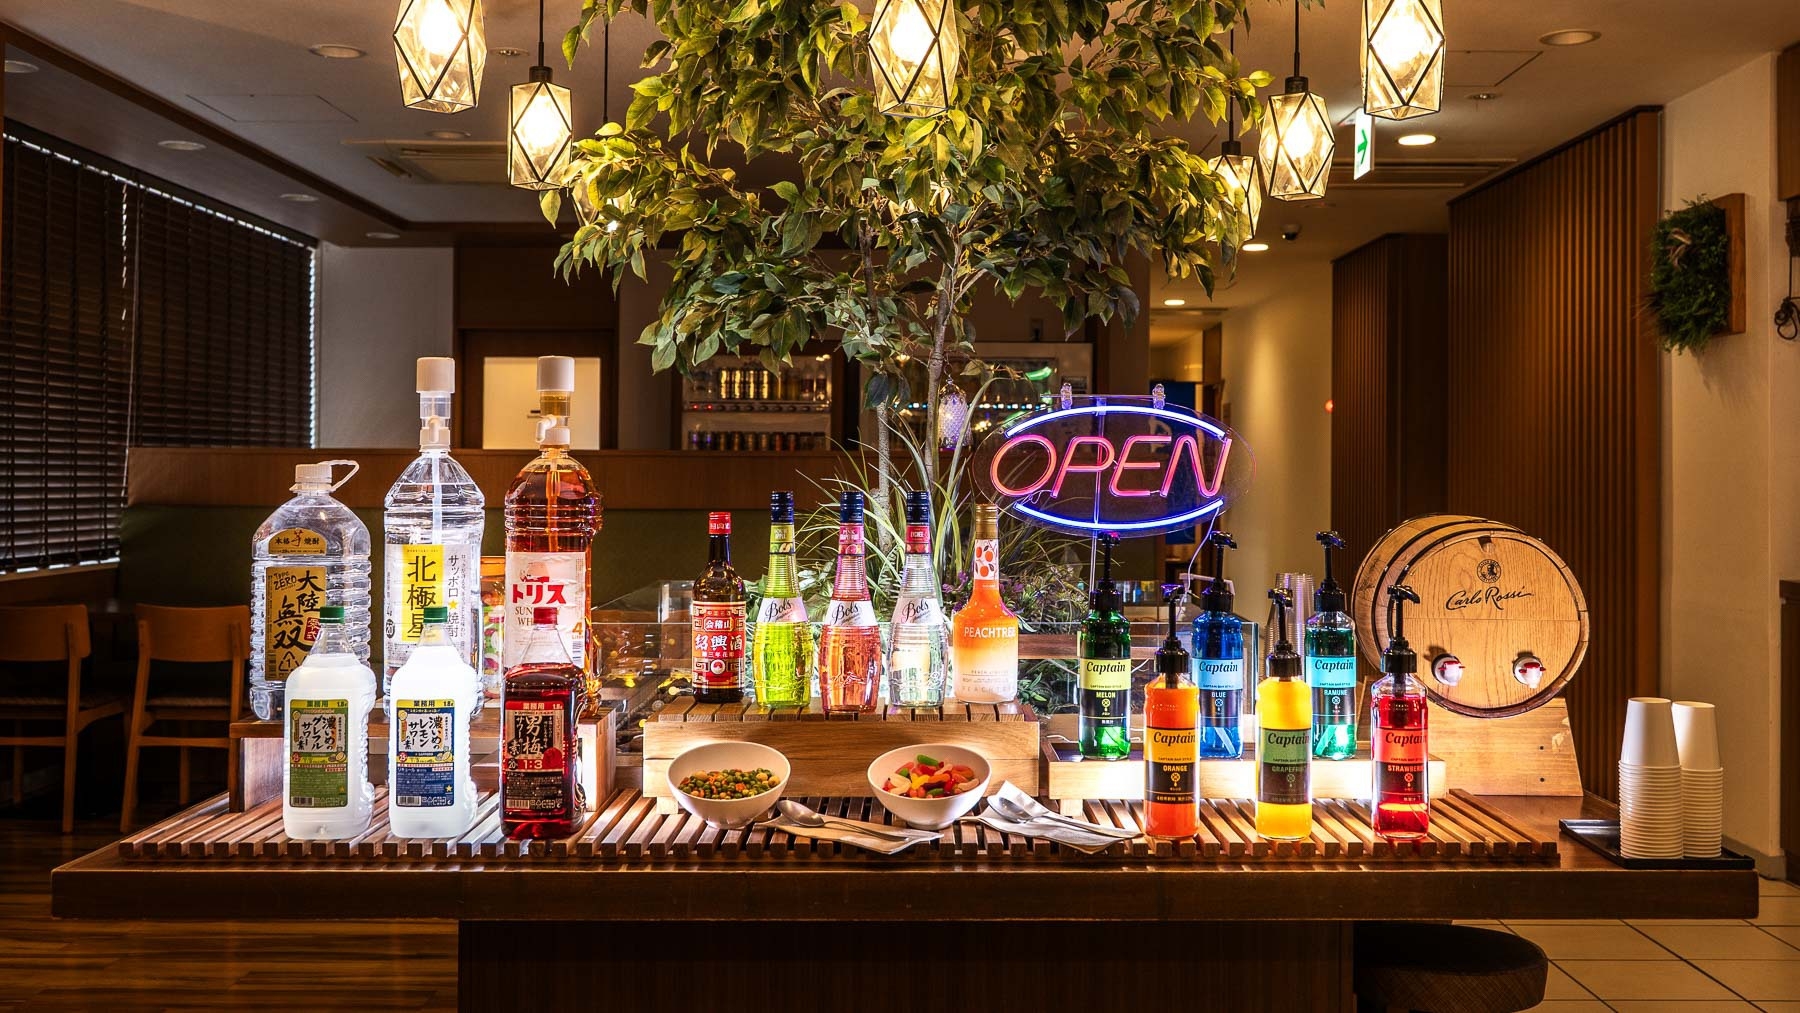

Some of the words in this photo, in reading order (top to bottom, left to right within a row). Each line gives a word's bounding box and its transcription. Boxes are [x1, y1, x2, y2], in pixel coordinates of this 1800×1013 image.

[990, 434, 1232, 498] OPEN
[273, 575, 297, 591] ZERO
[448, 554, 459, 598] サッポロ
[295, 570, 325, 613] 大陸
[407, 555, 437, 638] 北極星
[512, 584, 567, 605] トリス
[1446, 589, 1482, 611] Carlo
[1485, 586, 1534, 611] Rossi
[765, 600, 792, 621] Bols
[832, 600, 860, 623] Bols
[901, 601, 929, 622] Bols
[273, 594, 314, 652] 無双
[572, 621, 584, 636] 4
[964, 626, 1017, 639] PEACHTREE
[1086, 661, 1126, 675] Captain
[1199, 661, 1238, 675] Captain
[1314, 659, 1354, 673] Captain
[312, 715, 324, 751] グレフル
[322, 715, 337, 751] 濃いめの
[419, 718, 430, 748] レモン
[429, 715, 443, 750] 濃いめの
[522, 716, 544, 757] 男梅
[1153, 731, 1196, 747] Captain
[1268, 732, 1310, 748] Captain
[523, 759, 543, 769] 1:3
